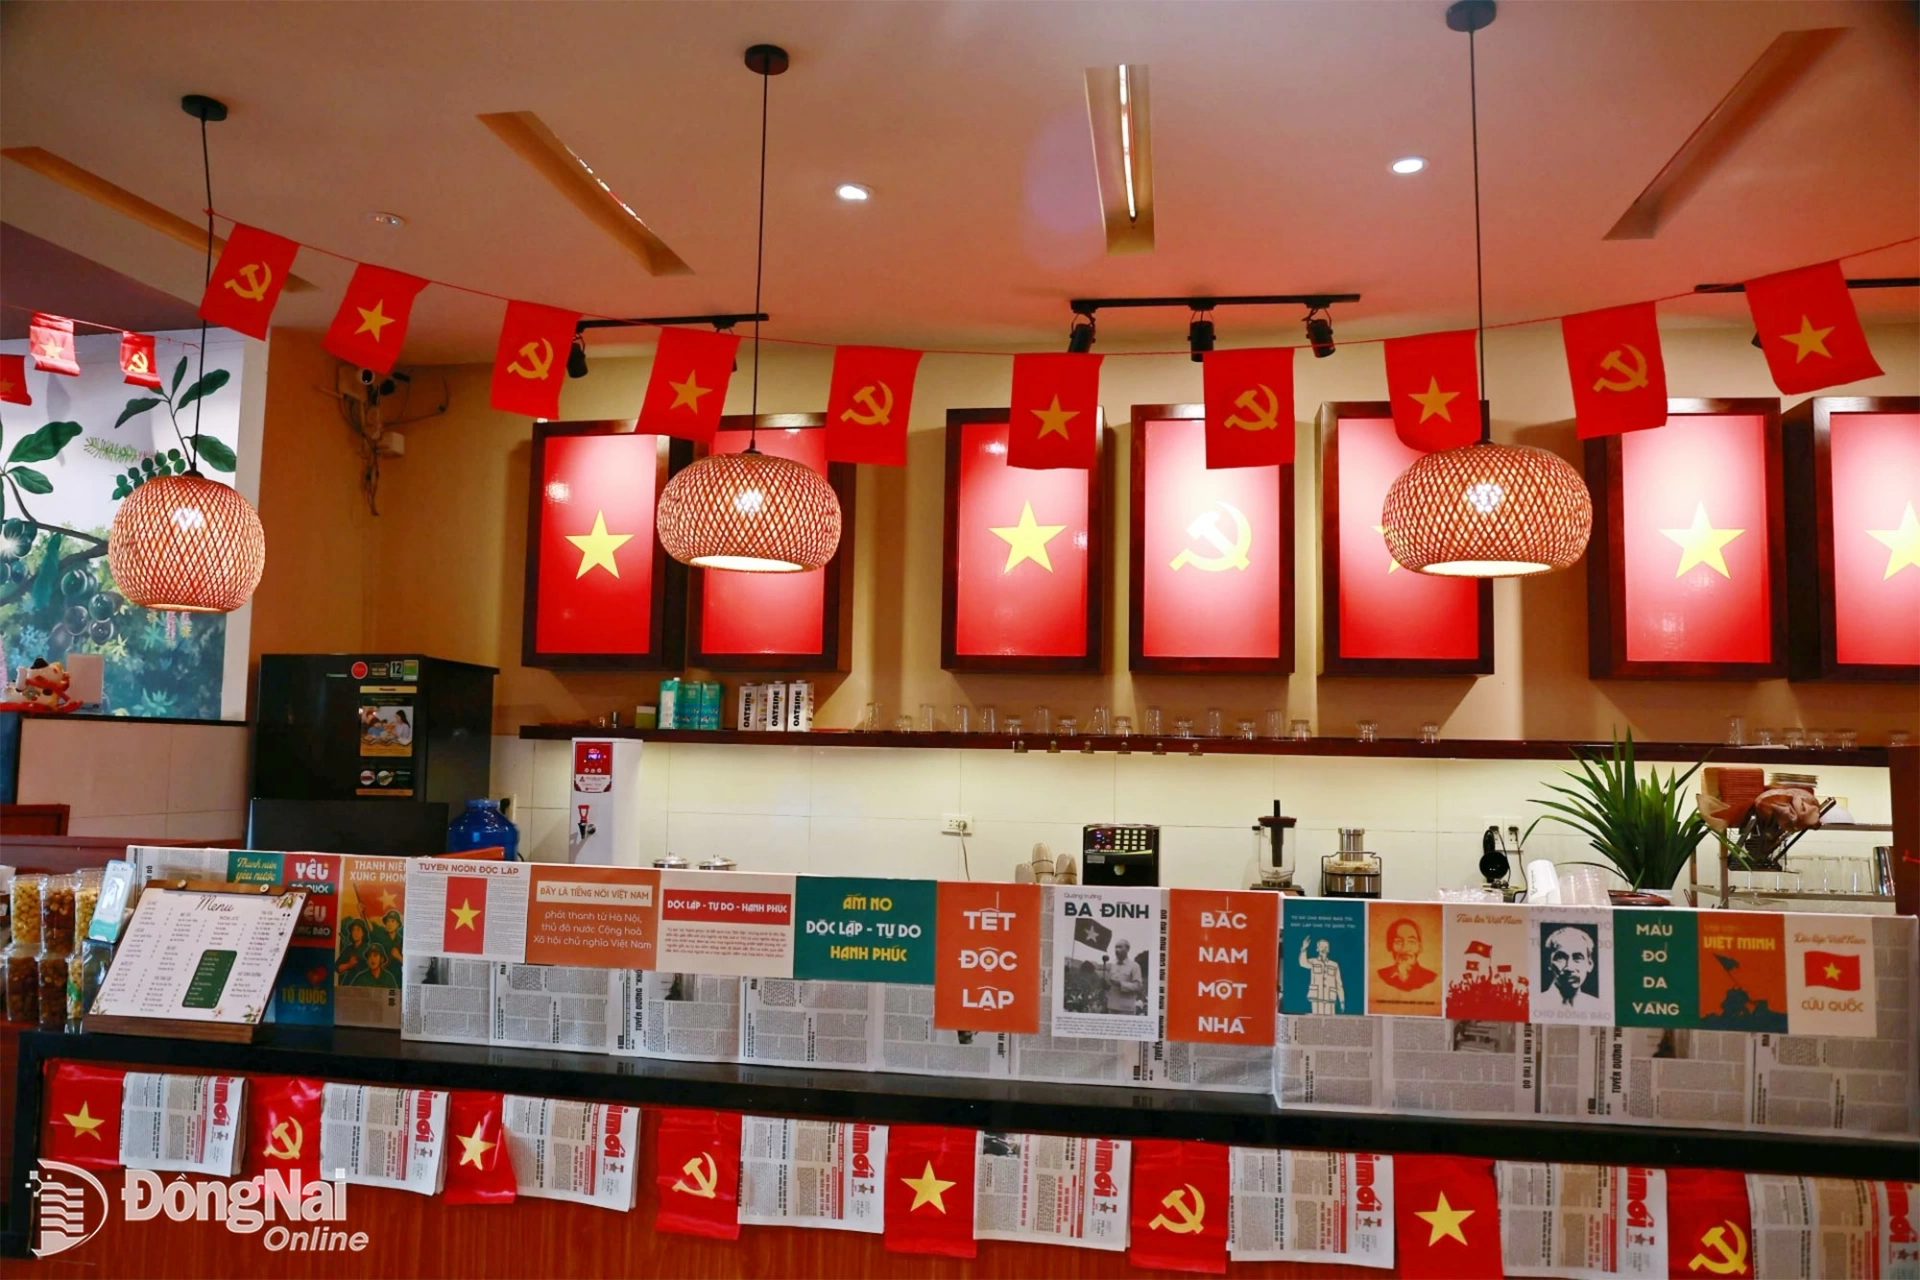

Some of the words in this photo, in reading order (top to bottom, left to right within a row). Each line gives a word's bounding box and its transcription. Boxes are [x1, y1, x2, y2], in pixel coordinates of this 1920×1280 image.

[772, 690, 780, 727] OATSIDE
[793, 690, 802, 727] OATSIDE
[295, 858, 328, 880] YÊU
[354, 860, 386, 871] THANH
[350, 871, 377, 881] XUNG
[379, 872, 406, 882] PHON
[570, 886, 592, 897] TIẾNG
[611, 889, 628, 900] VIỆT
[630, 891, 649, 900] NAM
[195, 895, 234, 912] Menu
[303, 900, 326, 921] ÊU
[721, 902, 734, 911] DO
[870, 897, 893, 911] NO
[963, 892, 1017, 931] TẾT
[1064, 901, 1093, 917] BA
[1099, 901, 1149, 919] ĐÌNH
[1201, 896, 1247, 929] BẮC
[545, 910, 566, 919] phát
[568, 911, 595, 920] thanh
[541, 922, 557, 931] thủ
[558, 923, 571, 932] đô
[573, 924, 595, 934] nước
[598, 925, 622, 937] Cộng
[806, 919, 836, 936] ĐỘC
[839, 920, 863, 937] LẬP
[898, 924, 922, 938] DO
[533, 935, 545, 943] Xã
[547, 935, 561, 945] hội
[563, 936, 580, 945] chủ
[582, 938, 609, 948] nghĩa
[611, 939, 628, 948] Việt
[631, 940, 652, 949] Nam
[1737, 937, 1776, 950] MINH
[872, 944, 907, 962] PHÚC
[958, 946, 1018, 972] ĐỘC
[1199, 946, 1248, 964] NAM
[1198, 979, 1247, 1000] MỘT
[1643, 976, 1668, 988] DA
[962, 985, 1015, 1011] LẬP
[1828, 998, 1864, 1012] QUỐC
[1198, 1016, 1252, 1034] NHÀ
